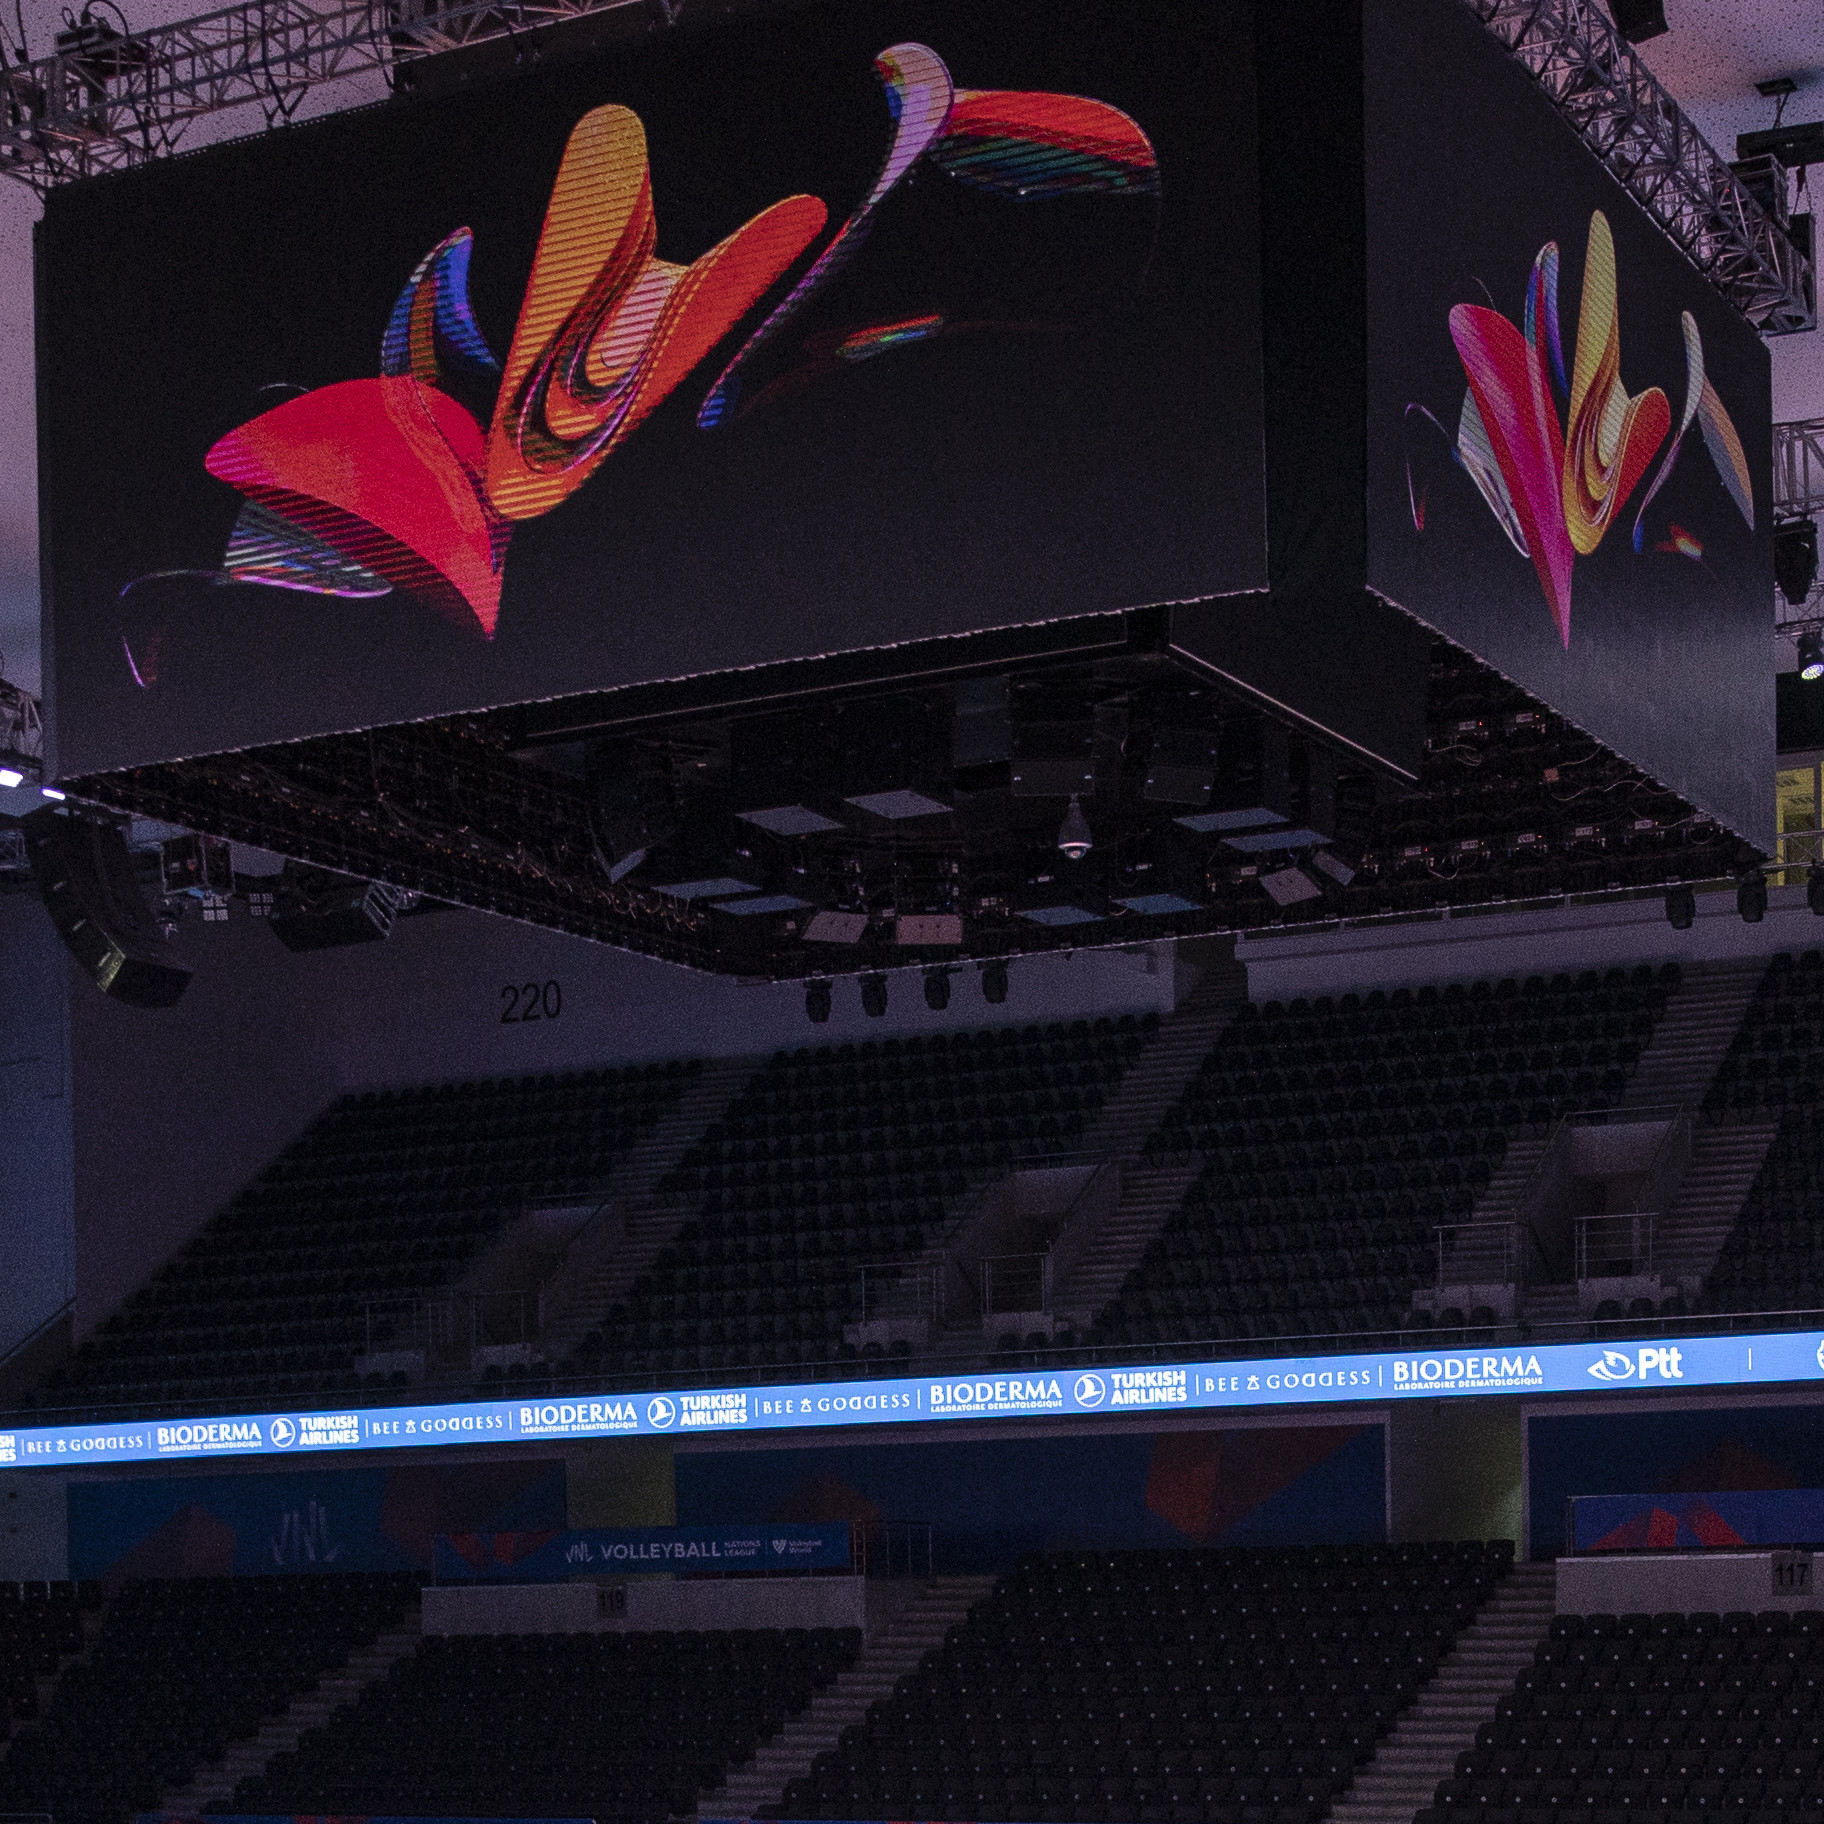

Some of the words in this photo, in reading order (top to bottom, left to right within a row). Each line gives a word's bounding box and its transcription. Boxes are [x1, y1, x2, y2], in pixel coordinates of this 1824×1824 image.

[501, 980, 562, 1023] 220
[1393, 1355, 1543, 1382] BIODERMA
[1638, 1348, 1684, 1380] Ptt
[1110, 1371, 1185, 1389] TURKISH
[1204, 1377, 1239, 1393] BEE
[1394, 1380, 1455, 1391] LABORATOIRE
[930, 1380, 1062, 1404] BIODERMA
[1110, 1387, 1187, 1406] AIRLINES
[679, 1393, 746, 1410] TURKISH
[763, 1400, 793, 1414] BEE
[519, 1401, 637, 1425] BIODERMA
[679, 1409, 747, 1426] AIRLINES
[299, 1415, 359, 1430] TURKISH
[373, 1421, 399, 1434] BEE
[158, 1421, 262, 1444] BIODERMA
[298, 1429, 360, 1445] AIRLINES
[27, 1441, 52, 1454] BEE
[600, 1541, 722, 1561] VOLLEYBALL
[1775, 1563, 1808, 1586] 117
[598, 1589, 624, 1611] 119
